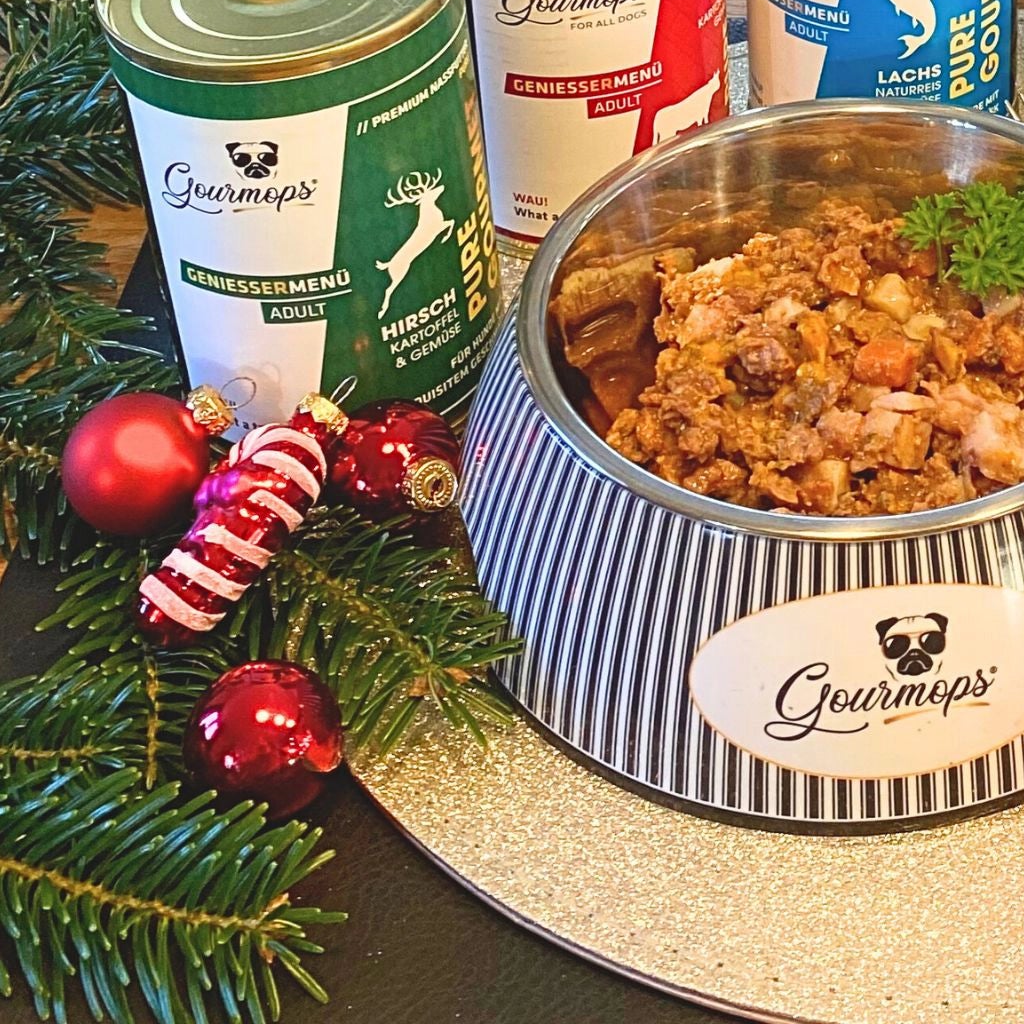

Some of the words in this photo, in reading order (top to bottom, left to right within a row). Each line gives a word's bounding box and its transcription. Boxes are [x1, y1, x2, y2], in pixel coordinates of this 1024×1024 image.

[570, 20, 594, 31] FOR
[596, 16, 616, 29] ALL
[617, 8, 648, 25] DOGS
[789, 20, 829, 42] ADULT
[949, 9, 976, 100] PURE
[513, 61, 662, 95] GENIESSERMENÜ
[878, 63, 942, 84] LACHS
[875, 80, 942, 97] NATURREIS
[372, 88, 429, 128] PREMIUM
[594, 93, 643, 114] ADULT
[513, 192, 548, 207] WAU!
[514, 206, 548, 221] What
[457, 211, 487, 321] PURE
[186, 268, 351, 296] GENIESSERMENÜ
[270, 302, 326, 320] ADULT
[381, 288, 456, 341] HIRSCH
[390, 308, 460, 354] KARTOFFEL
[395, 357, 407, 368] &
[410, 321, 461, 361] GEMÜSE
[450, 346, 471, 368] FÜR
